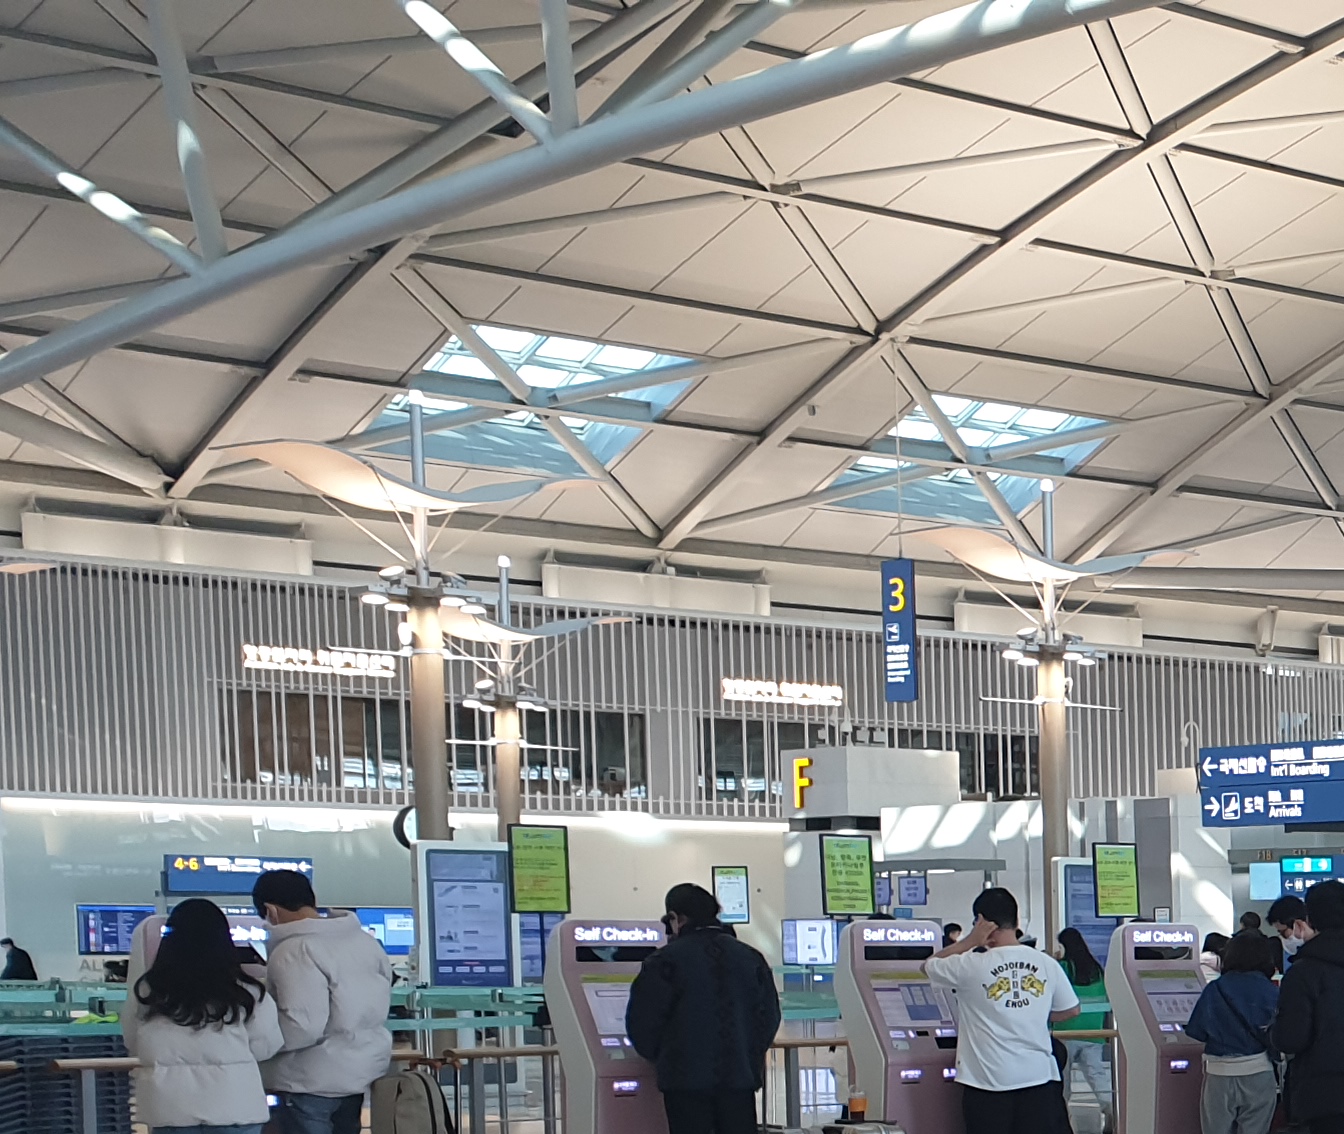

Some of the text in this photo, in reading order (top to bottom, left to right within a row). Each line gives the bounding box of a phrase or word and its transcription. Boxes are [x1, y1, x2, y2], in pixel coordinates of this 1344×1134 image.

[888, 576, 906, 613] 3
[1270, 762, 1330, 776] Int'l Boarding
[793, 757, 813, 809] F
[1244, 796, 1264, 814] 도착
[1268, 804, 1302, 818] Arrivals
[174, 857, 200, 871] 4-6
[574, 927, 658, 941] Self Check-in
[863, 928, 934, 941] Self Check-in
[1133, 930, 1193, 943] Self Check-in
